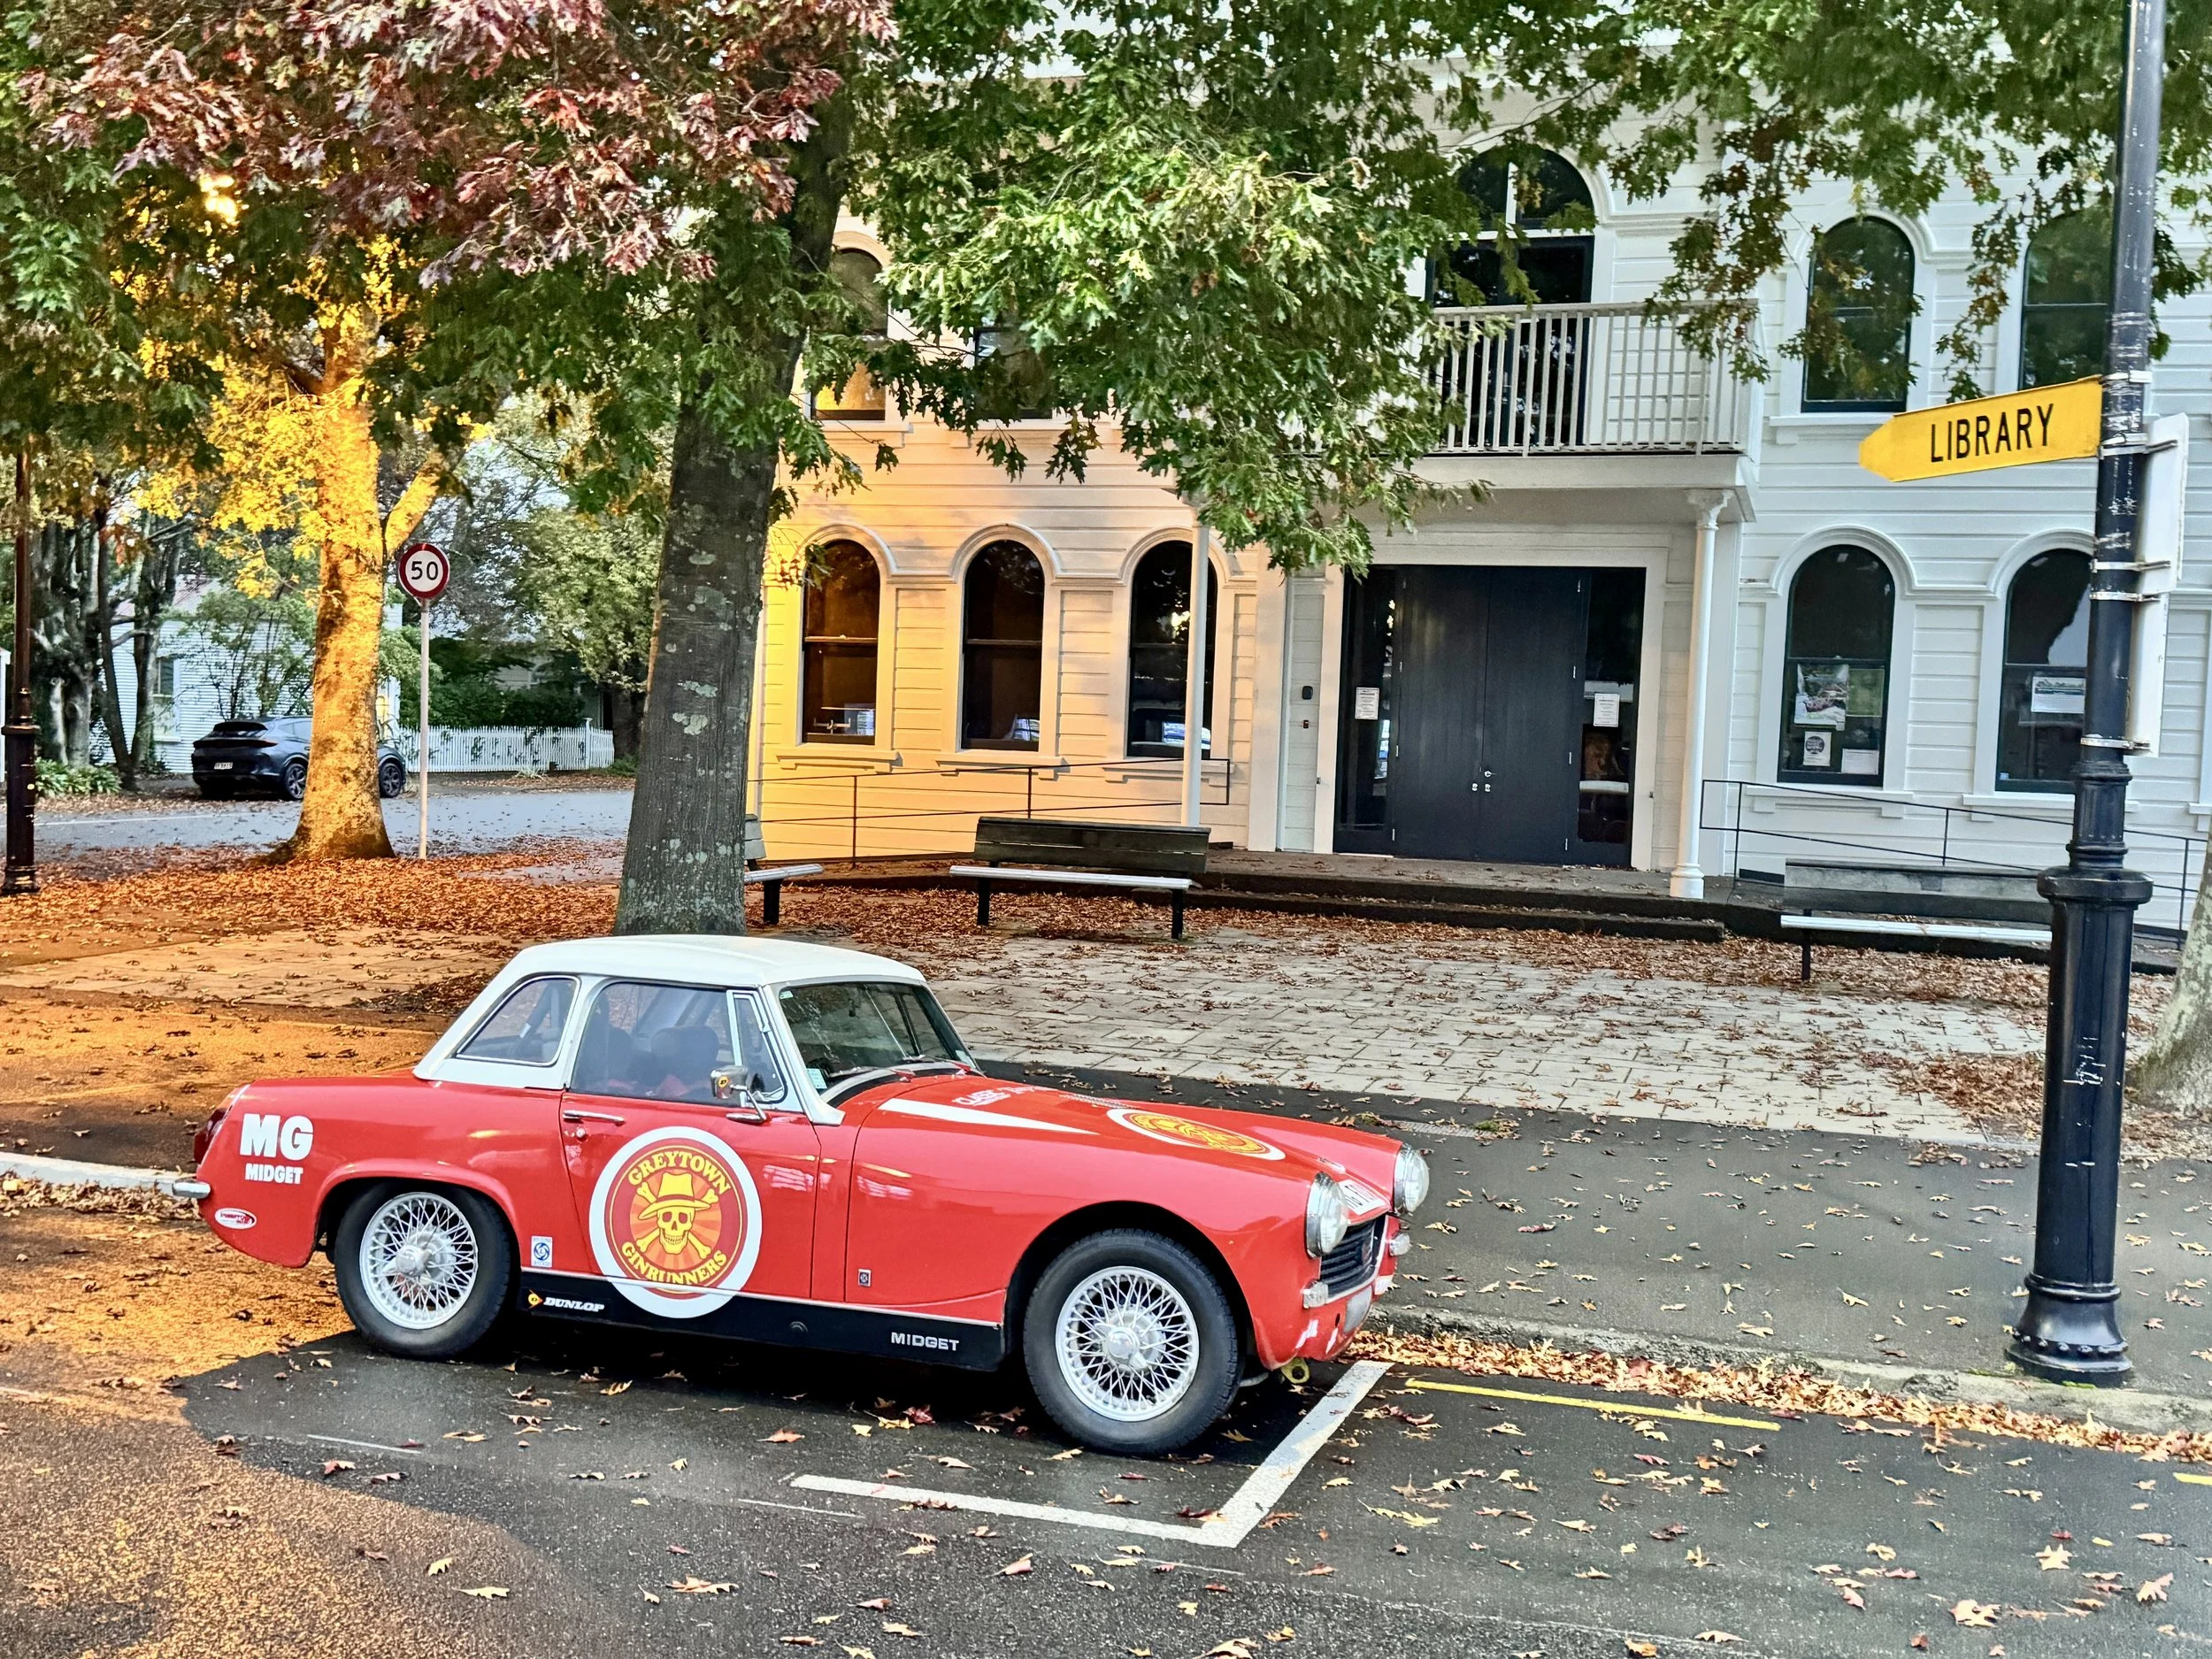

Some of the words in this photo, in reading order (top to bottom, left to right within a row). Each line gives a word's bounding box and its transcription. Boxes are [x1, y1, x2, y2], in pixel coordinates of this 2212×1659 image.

[1930, 403, 2054, 464] LIBRARY
[411, 560, 439, 580] 50
[239, 1112, 314, 1161] MG
[244, 1162, 304, 1184] MIDGET
[627, 1150, 732, 1194] GREYTOWN
[621, 1241, 727, 1286] GINRUNNERS
[542, 1296, 605, 1313] DUNLOP
[891, 1331, 960, 1352] MIDGET
